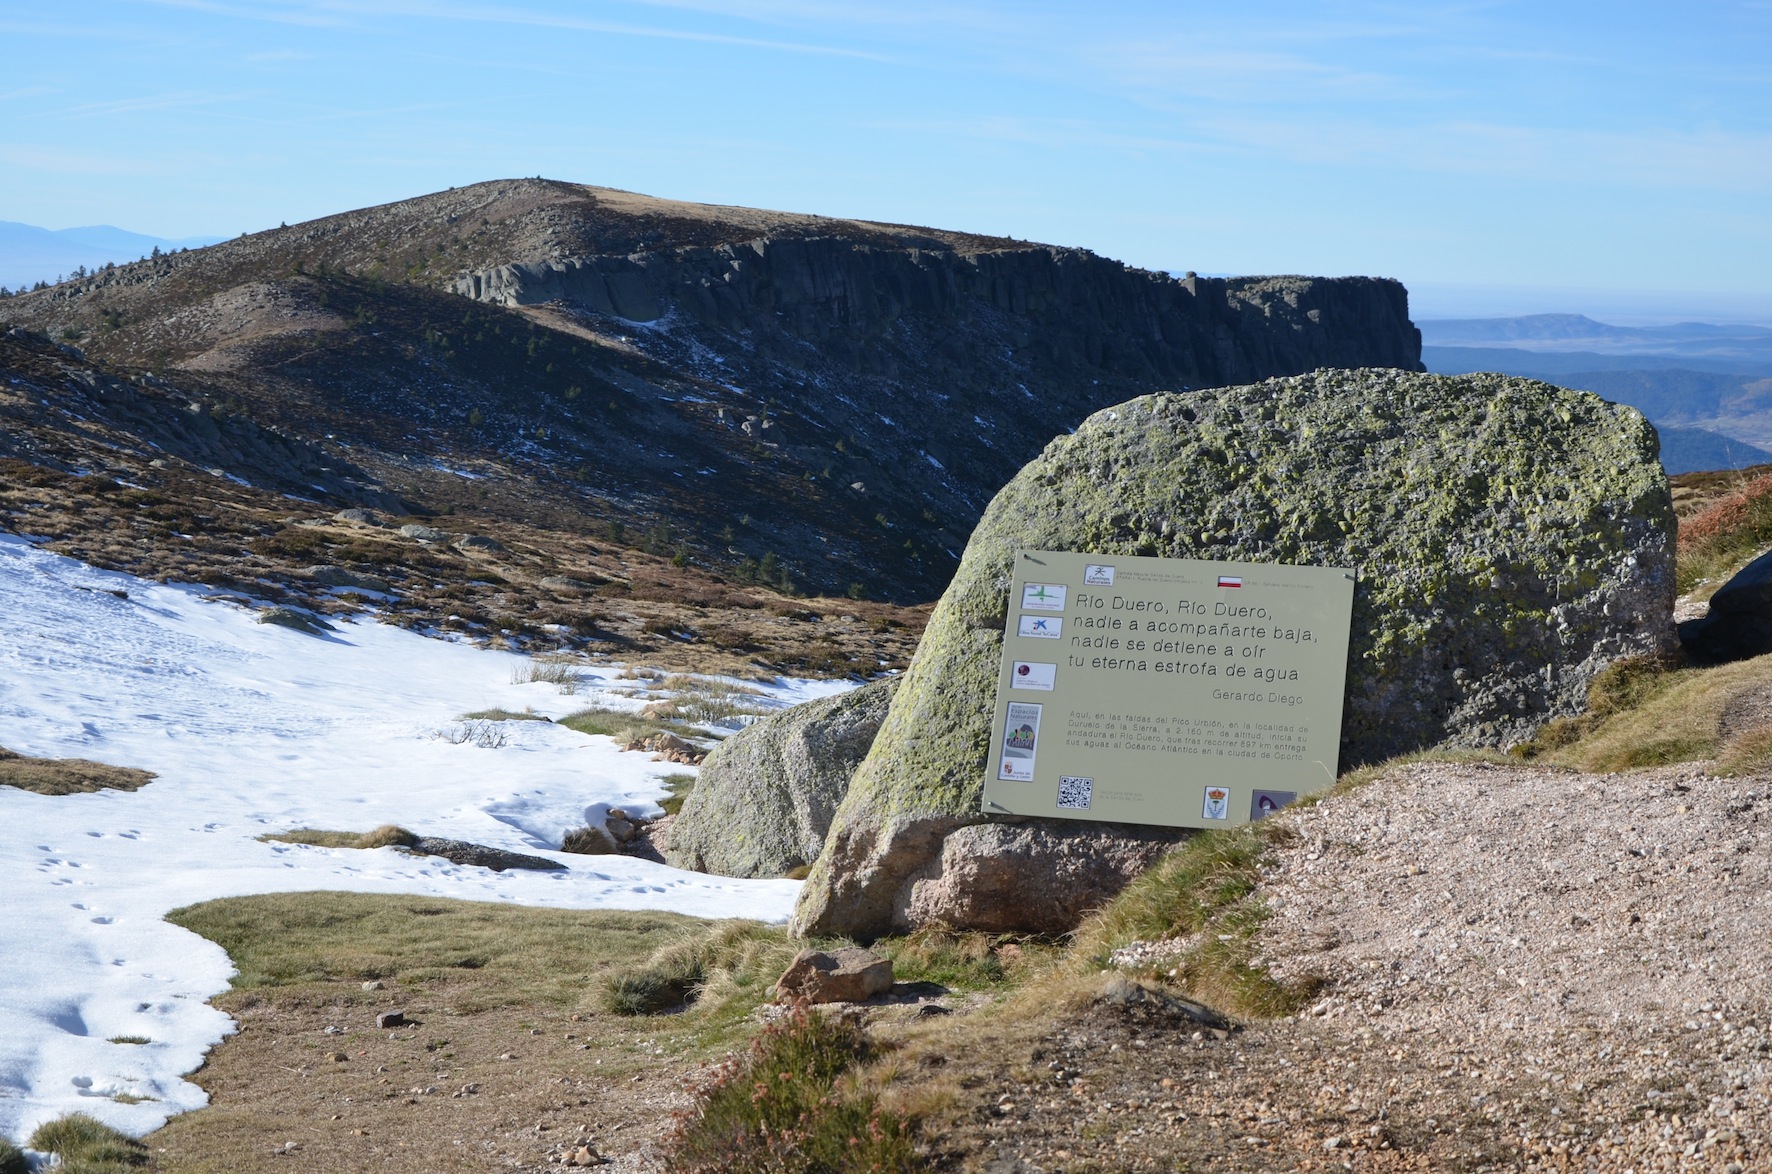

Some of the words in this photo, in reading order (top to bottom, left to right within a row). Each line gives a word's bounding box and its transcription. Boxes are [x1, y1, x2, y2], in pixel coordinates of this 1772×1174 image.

[1076, 594, 1104, 609] Río
[1112, 596, 1169, 614] Duero,
[1178, 600, 1206, 615] Río
[1214, 602, 1272, 620] Duero,
[1074, 616, 1122, 630] nadie
[1129, 620, 1138, 630] a
[1146, 620, 1266, 638] acompañarte
[1274, 626, 1318, 644] baja,
[1071, 635, 1120, 649] nadie
[1126, 640, 1146, 650] se
[1154, 639, 1216, 655] detiene
[1224, 646, 1234, 656] a
[1242, 645, 1266, 658] oír
[1068, 654, 1084, 666] tu
[1092, 656, 1147, 671] eterna
[1155, 661, 1216, 676] estrofa
[1226, 664, 1246, 678] de
[1254, 668, 1299, 682] agua
[1212, 689, 1264, 702] Gerardo
[1268, 692, 1304, 706] Diego
[1068, 720, 1100, 728] Duruelo
[1133, 724, 1160, 734] Sierra,
[1270, 734, 1292, 742] inicia
[1126, 714, 1151, 723] faldas
[1172, 717, 1190, 726] Pico
[1256, 723, 1294, 732] localidad
[1067, 730, 1106, 739] andadura
[1136, 733, 1164, 743] Duero,
[1166, 736, 1182, 744] que
[1204, 738, 1238, 748] recorrer
[1240, 740, 1256, 748] 897
[1260, 742, 1272, 750] km
[1274, 743, 1306, 753] entrega
[1084, 740, 1110, 748] aguas
[1160, 744, 1198, 754] Atlántico
[1216, 748, 1224, 756] la
[1228, 750, 1256, 758] ciudad
[1260, 752, 1270, 760] de
